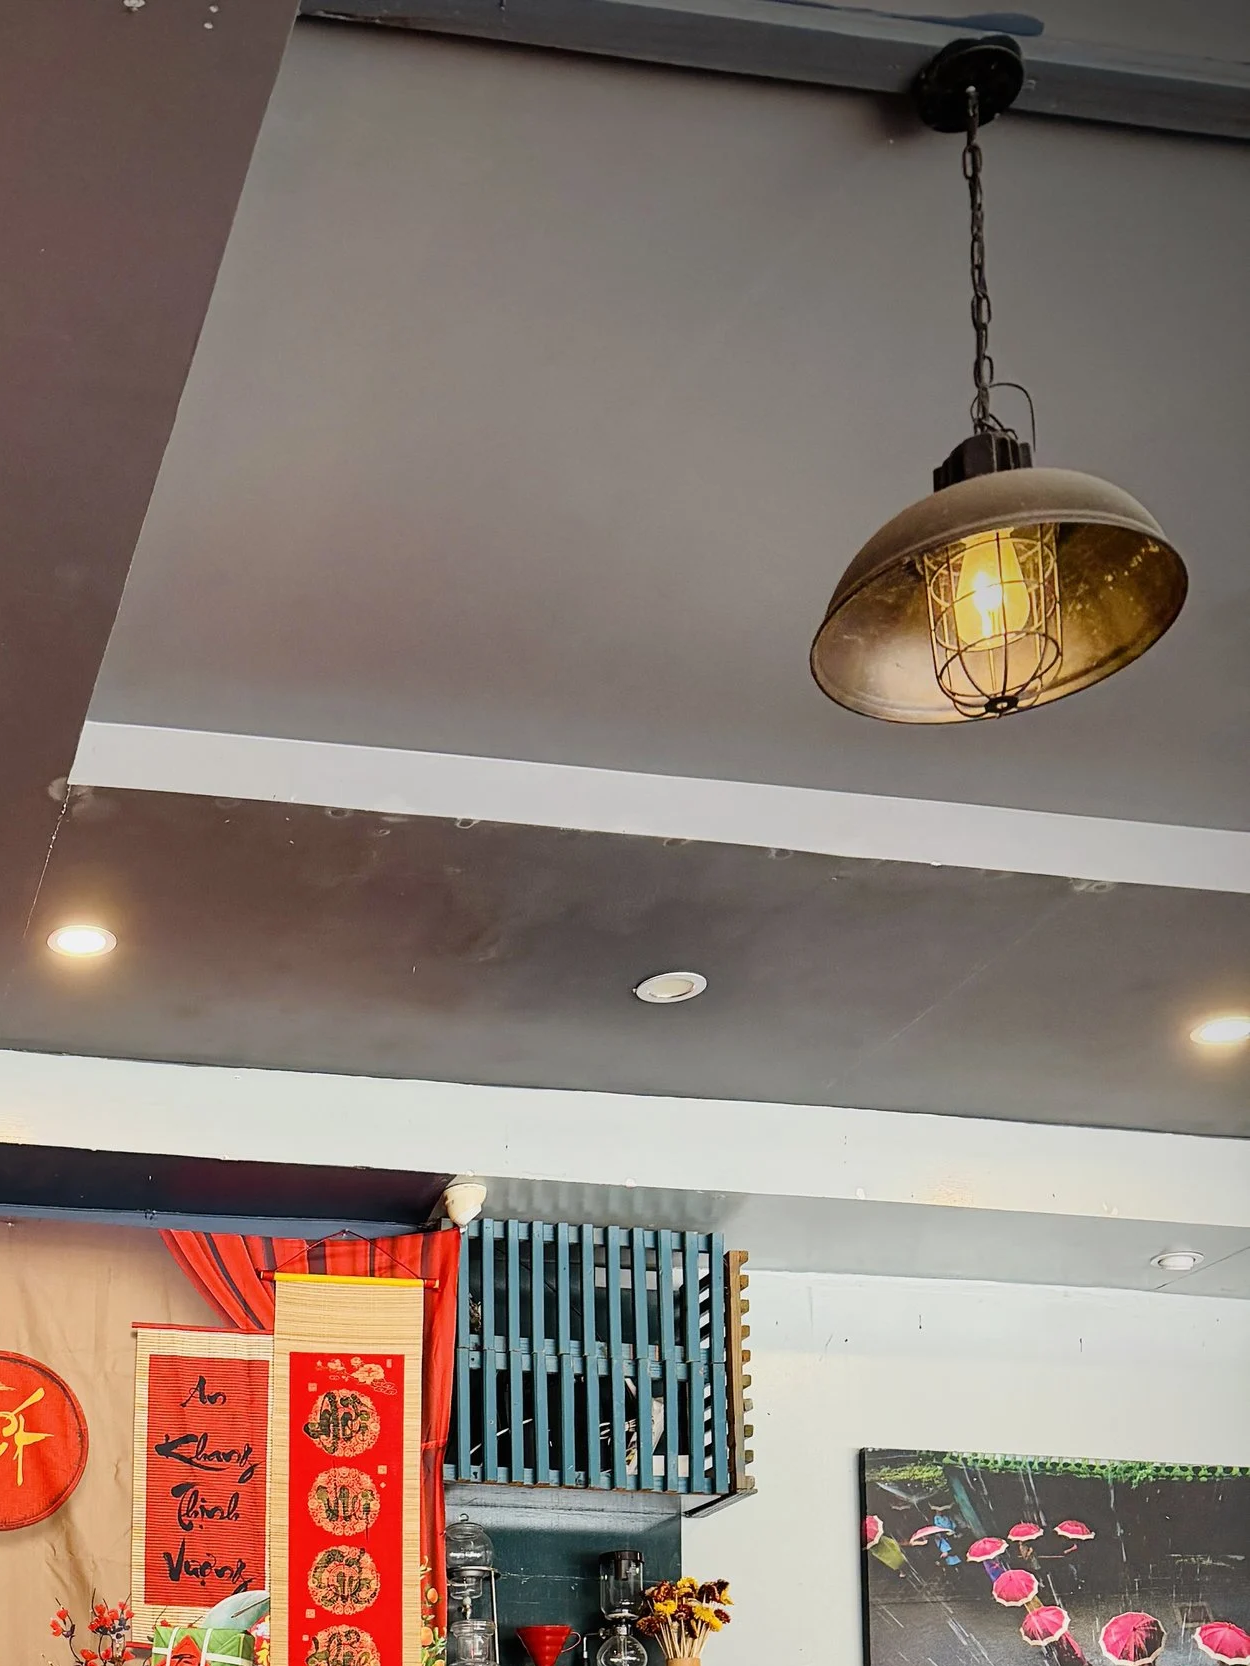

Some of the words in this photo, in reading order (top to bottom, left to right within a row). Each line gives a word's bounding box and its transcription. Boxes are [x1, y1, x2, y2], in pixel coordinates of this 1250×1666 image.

[180, 1375, 227, 1408] An
[154, 1432, 264, 1484] Khang
[170, 1481, 240, 1532] Thịnh
[163, 1538, 254, 1596] Vượng
